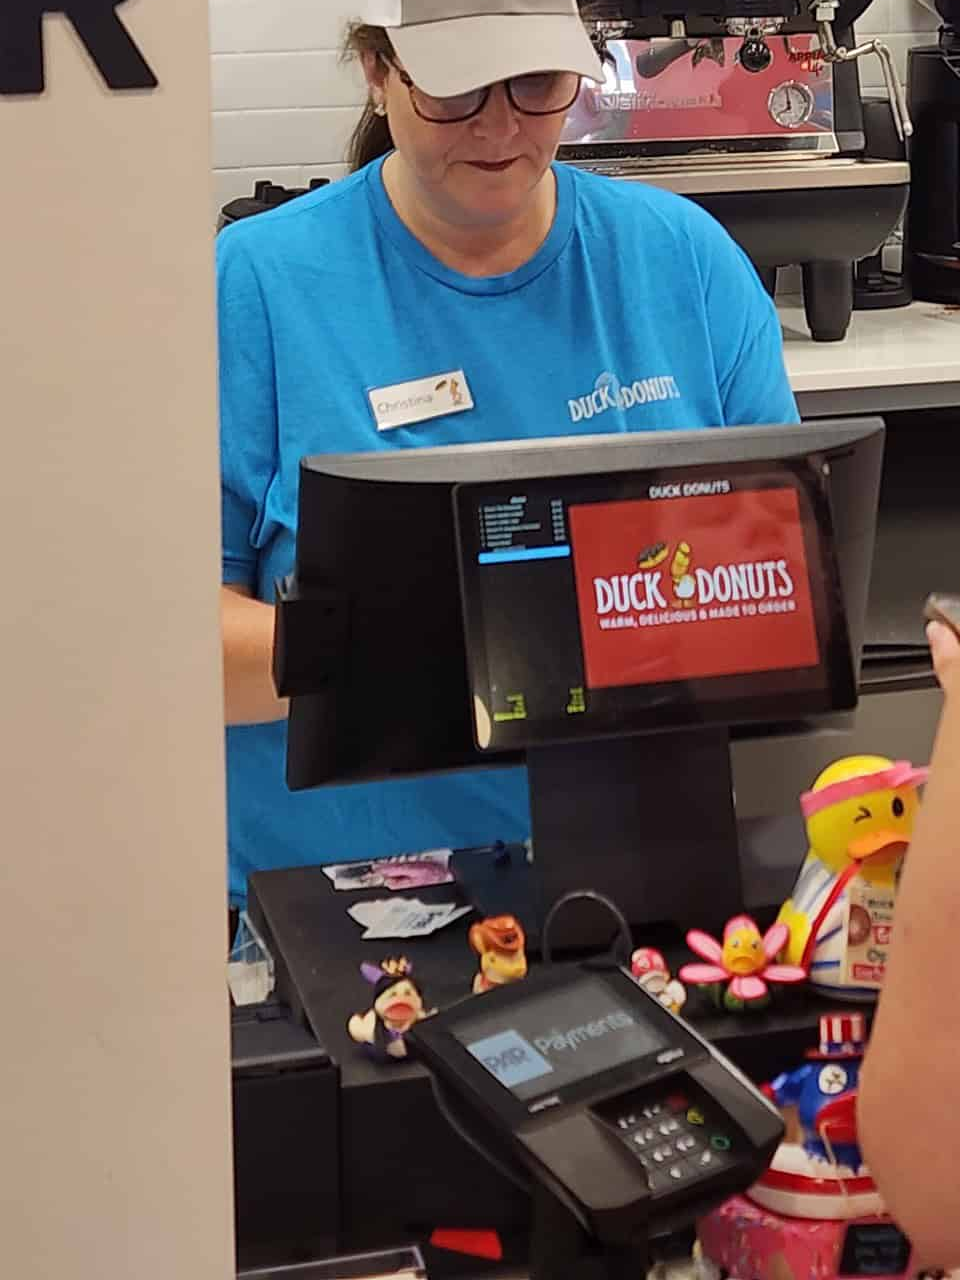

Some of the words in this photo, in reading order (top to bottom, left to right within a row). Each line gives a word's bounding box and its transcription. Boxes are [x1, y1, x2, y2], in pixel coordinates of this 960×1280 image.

[377, 394, 433, 414] Christina
[568, 386, 615, 422] DUCK
[649, 484, 681, 499] DUCK
[683, 480, 731, 497] DONUTS
[592, 571, 667, 614] DUCK
[696, 559, 794, 603] DONUTS
[600, 616, 639, 630] WARM,
[640, 610, 697, 627] DELICIOUS
[699, 610, 708, 621] &
[709, 606, 740, 618] MADE
[742, 605, 756, 616] TO
[758, 600, 796, 615] ORDER
[533, 1010, 633, 1058] Payments
